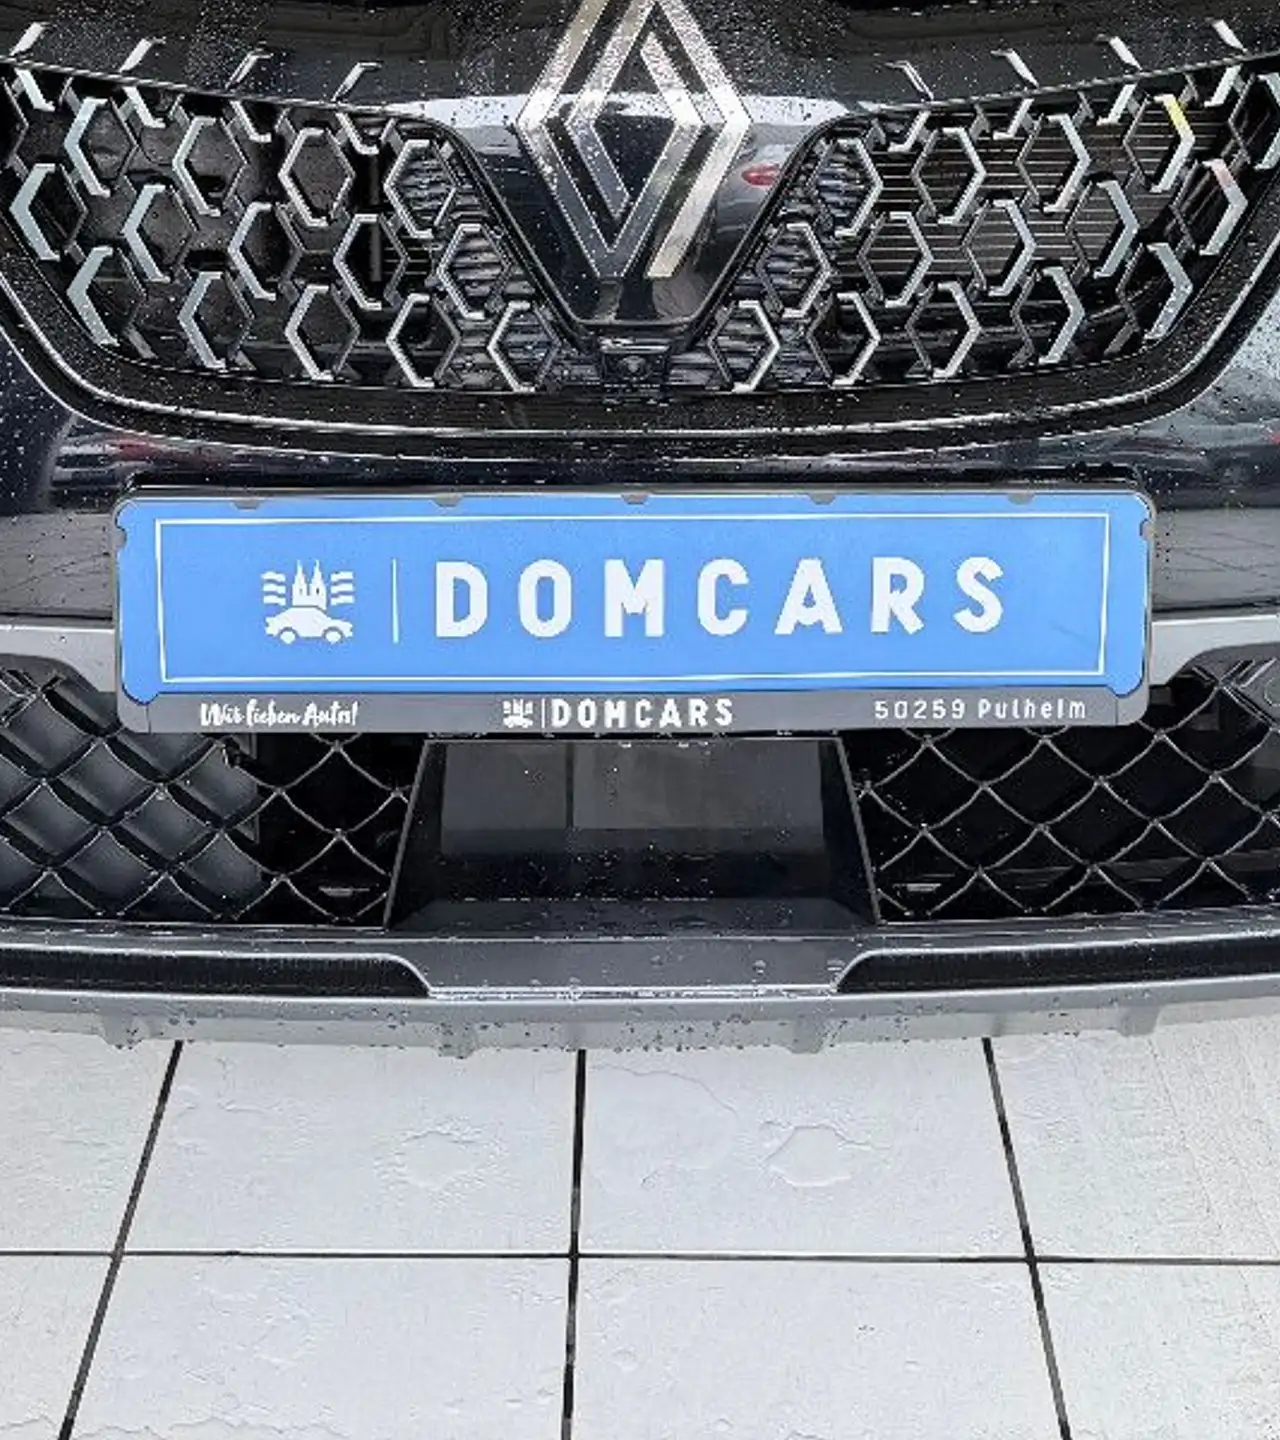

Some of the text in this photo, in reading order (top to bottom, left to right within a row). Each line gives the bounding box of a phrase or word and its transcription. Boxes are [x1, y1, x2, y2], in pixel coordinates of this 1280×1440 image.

[434, 556, 1005, 638] DOMCARS
[550, 698, 734, 729] DOMCARS
[874, 698, 966, 721] 50259
